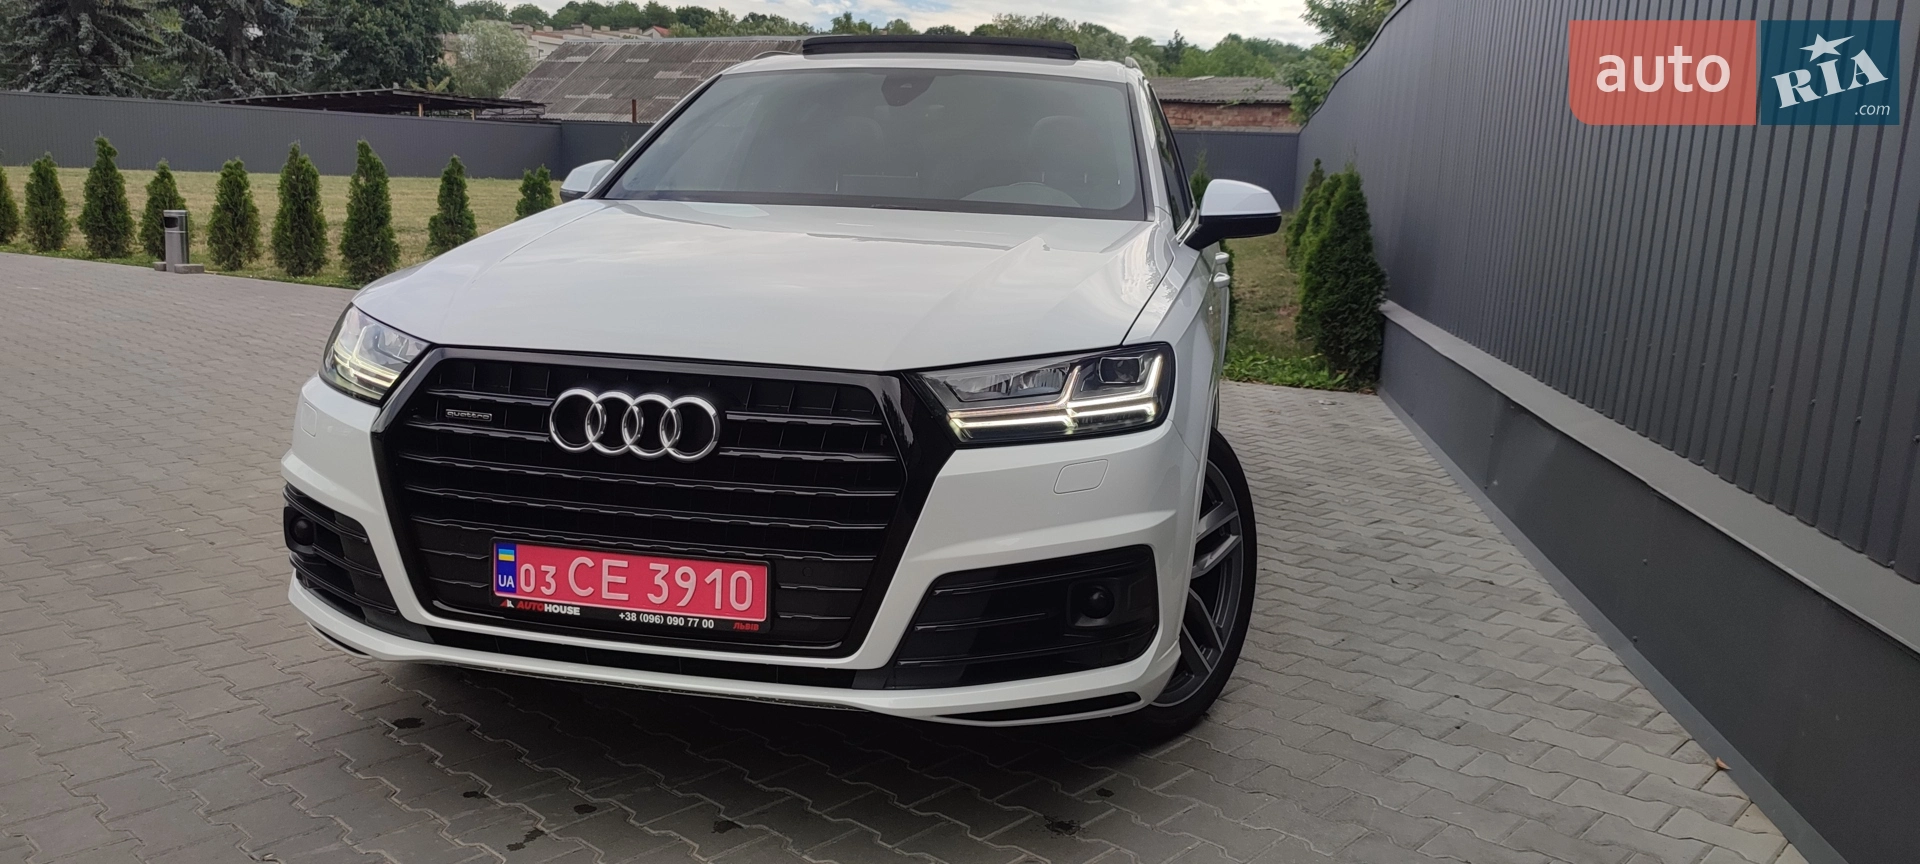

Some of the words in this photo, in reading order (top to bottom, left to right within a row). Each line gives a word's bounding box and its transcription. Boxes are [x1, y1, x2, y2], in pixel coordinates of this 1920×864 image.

[447, 411, 489, 419] quattro
[499, 575, 515, 588] UA
[520, 563, 557, 595] 03
[568, 556, 629, 600] CE
[647, 562, 753, 611] 3910
[517, 601, 580, 615] AUTOHOUSE
[619, 612, 637, 621] +38
[639, 613, 664, 624] (096)
[666, 616, 685, 626] 090
[687, 618, 699, 627] 77
[702, 619, 714, 628] 00
